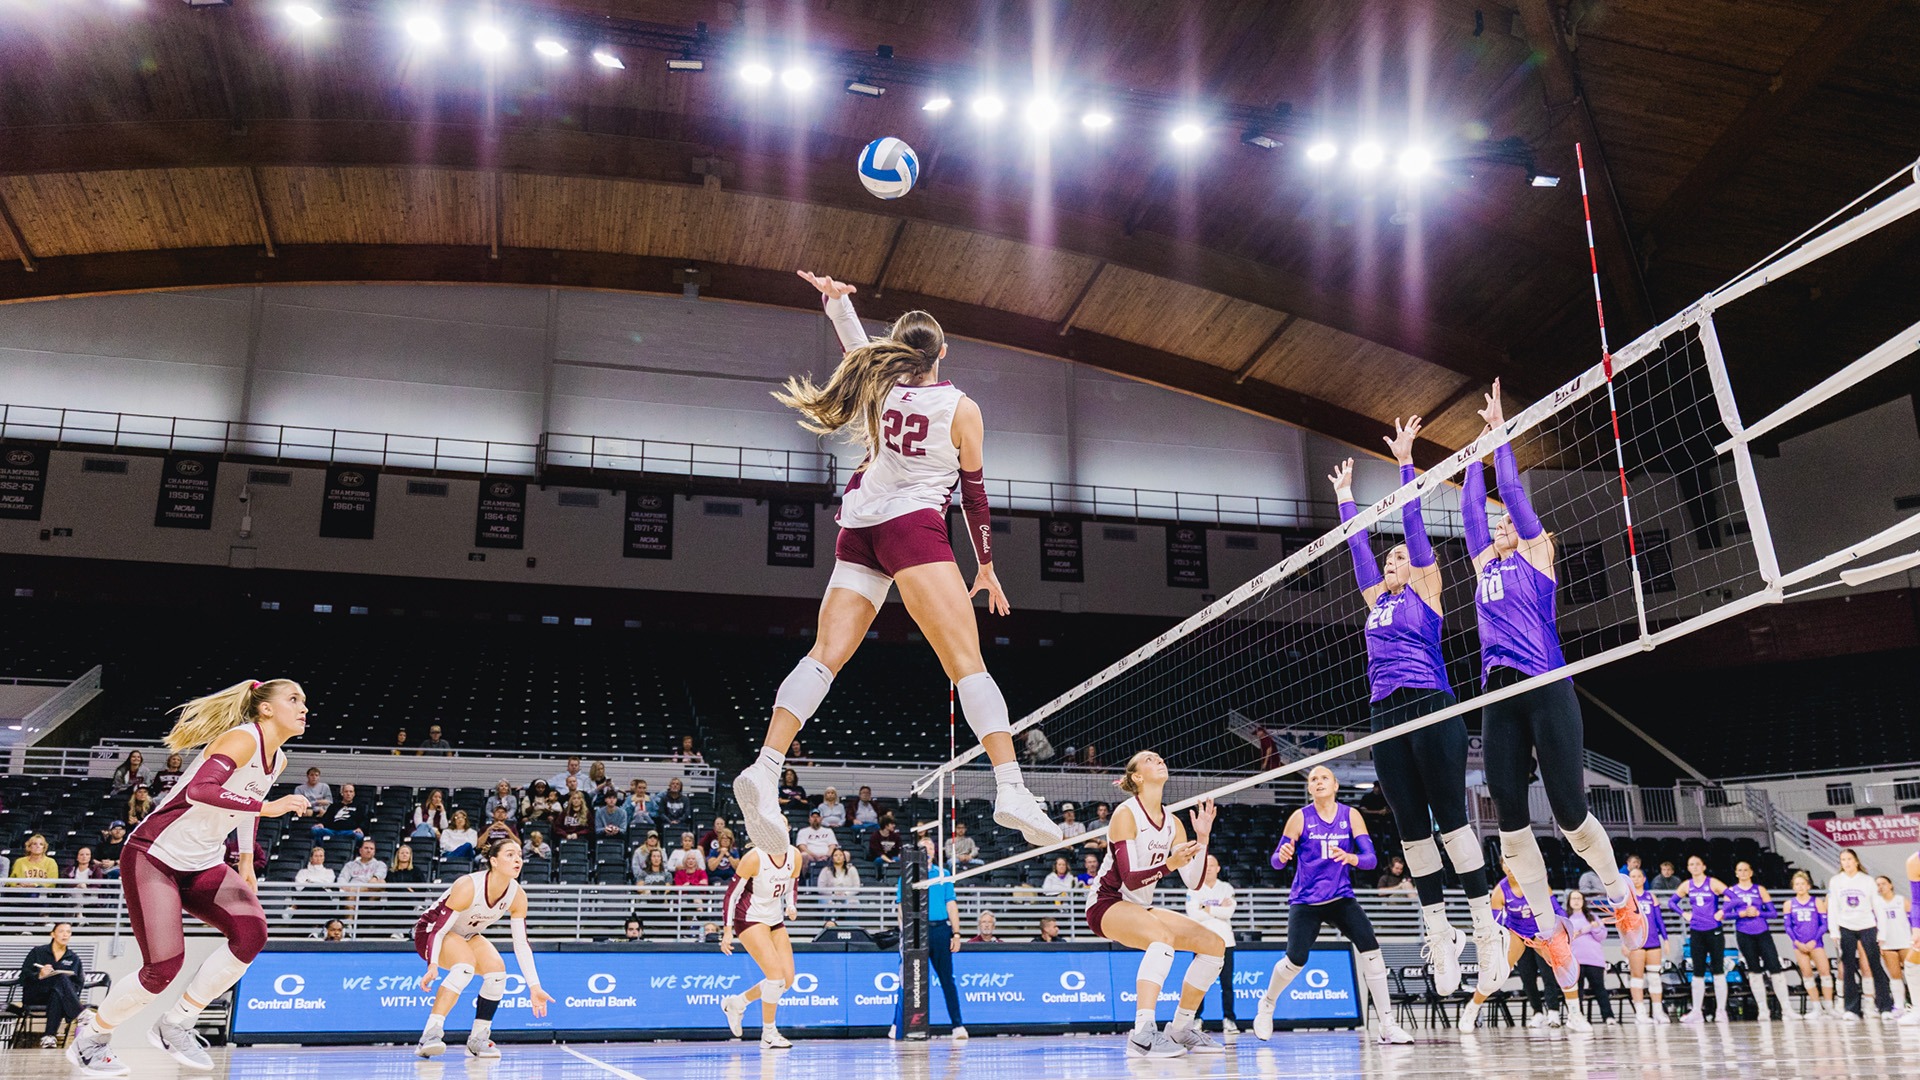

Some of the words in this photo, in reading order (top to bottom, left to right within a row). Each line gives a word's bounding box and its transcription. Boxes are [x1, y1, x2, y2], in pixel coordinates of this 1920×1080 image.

[1555, 377, 1580, 403] EKU
[901, 391, 917, 403] E
[882, 408, 930, 457] 22
[1458, 442, 1479, 462] EKU
[168, 478, 208, 486] CHAMPIONS
[330, 489, 370, 497] CHAMPIONS
[333, 502, 365, 511] 1960-61
[634, 524, 663, 532] 1971-72
[1481, 573, 1504, 604] 10
[1832, 832, 1865, 842] Bank
[1868, 830, 1878, 840] &
[1880, 828, 1916, 839] Trust
[1150, 853, 1164, 866] 12
[343, 976, 372, 990] WE
[650, 976, 677, 989] WE
[681, 975, 741, 990] START
[960, 973, 1013, 988] START
[686, 995, 719, 1005] WITH
[855, 994, 892, 1005] Central
[965, 992, 996, 1002] WITH
[997, 992, 1024, 1002] YOU.
[1042, 992, 1078, 1003] Central
[1080, 992, 1105, 1002] Bank
[1290, 989, 1323, 1000] Central
[1324, 989, 1348, 999] Bank
[248, 998, 293, 1010] Central
[294, 998, 326, 1009] Bank
[381, 996, 416, 1007] WITH
[565, 997, 606, 1007] Central
[607, 996, 636, 1007] Bank
[778, 996, 809, 1006] entral
[811, 996, 839, 1006] Bank
